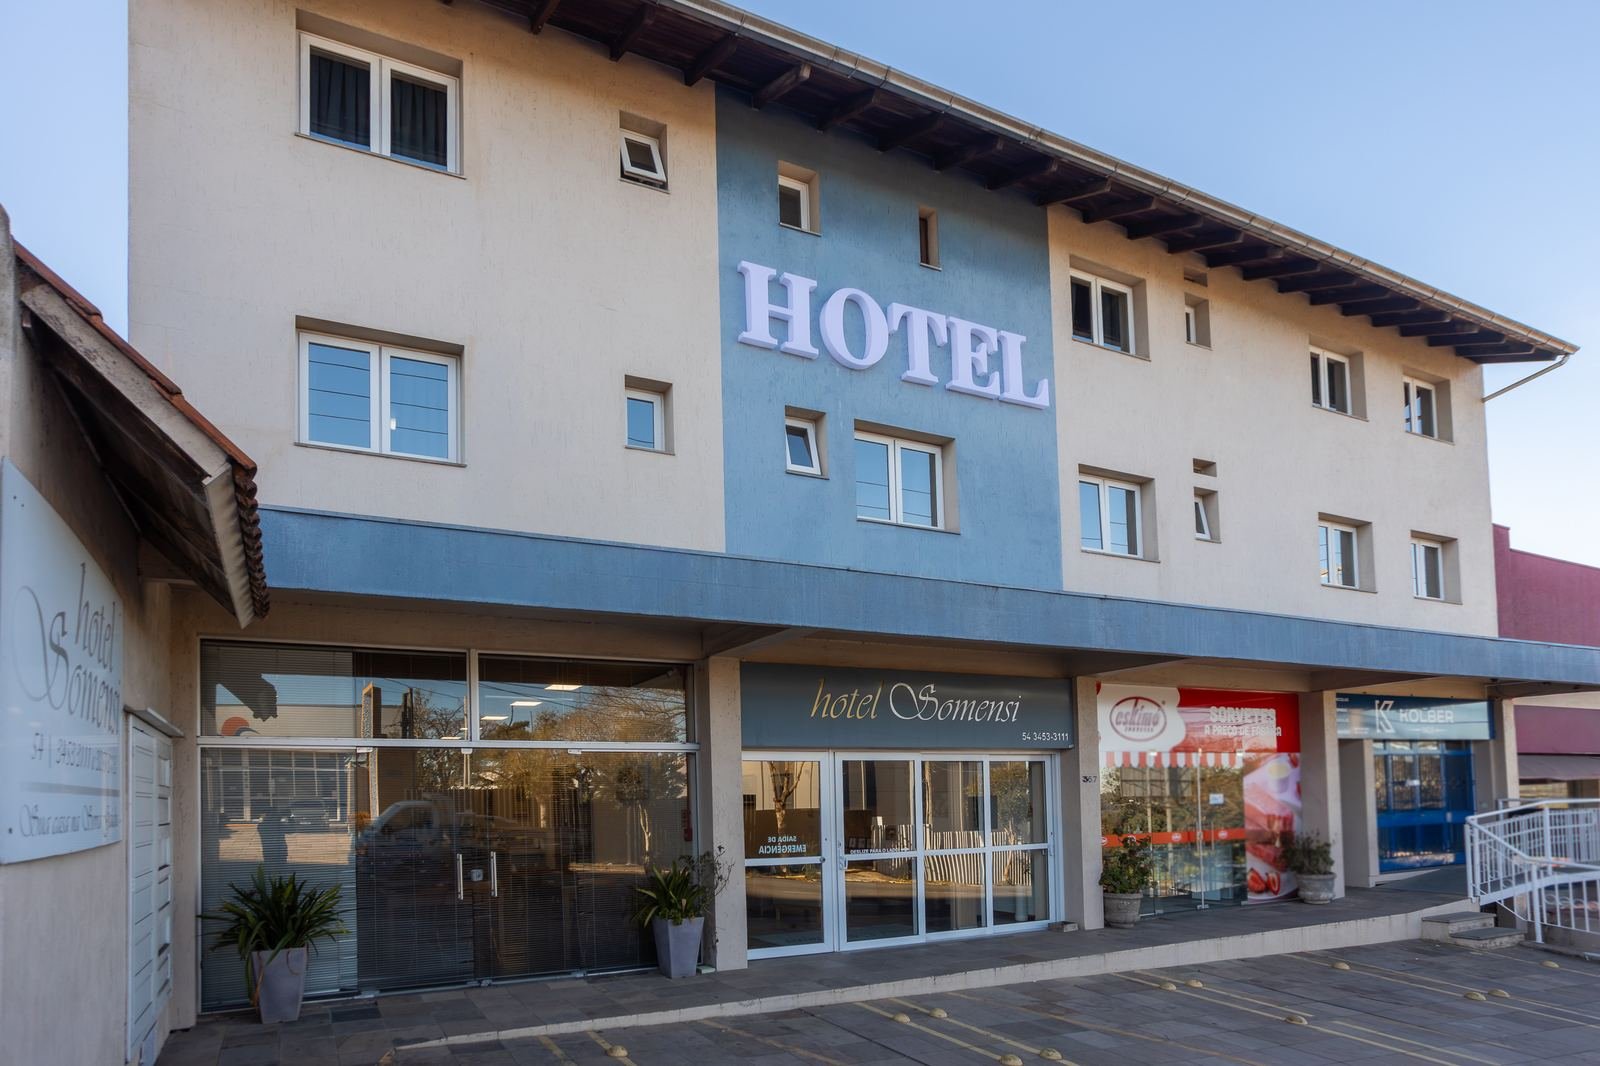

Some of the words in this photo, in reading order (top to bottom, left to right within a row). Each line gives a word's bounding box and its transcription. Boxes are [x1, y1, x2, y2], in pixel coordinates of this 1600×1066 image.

[737, 260, 1050, 410] HOTEL
[75, 562, 116, 673] hotel
[13, 585, 120, 736] Somensi
[810, 678, 885, 720] hotel
[889, 682, 1022, 722] Somensi
[1022, 731, 1031, 741] 54
[1032, 731, 1069, 742] 3453-3111
[1400, 708, 1455, 724] KOLBER
